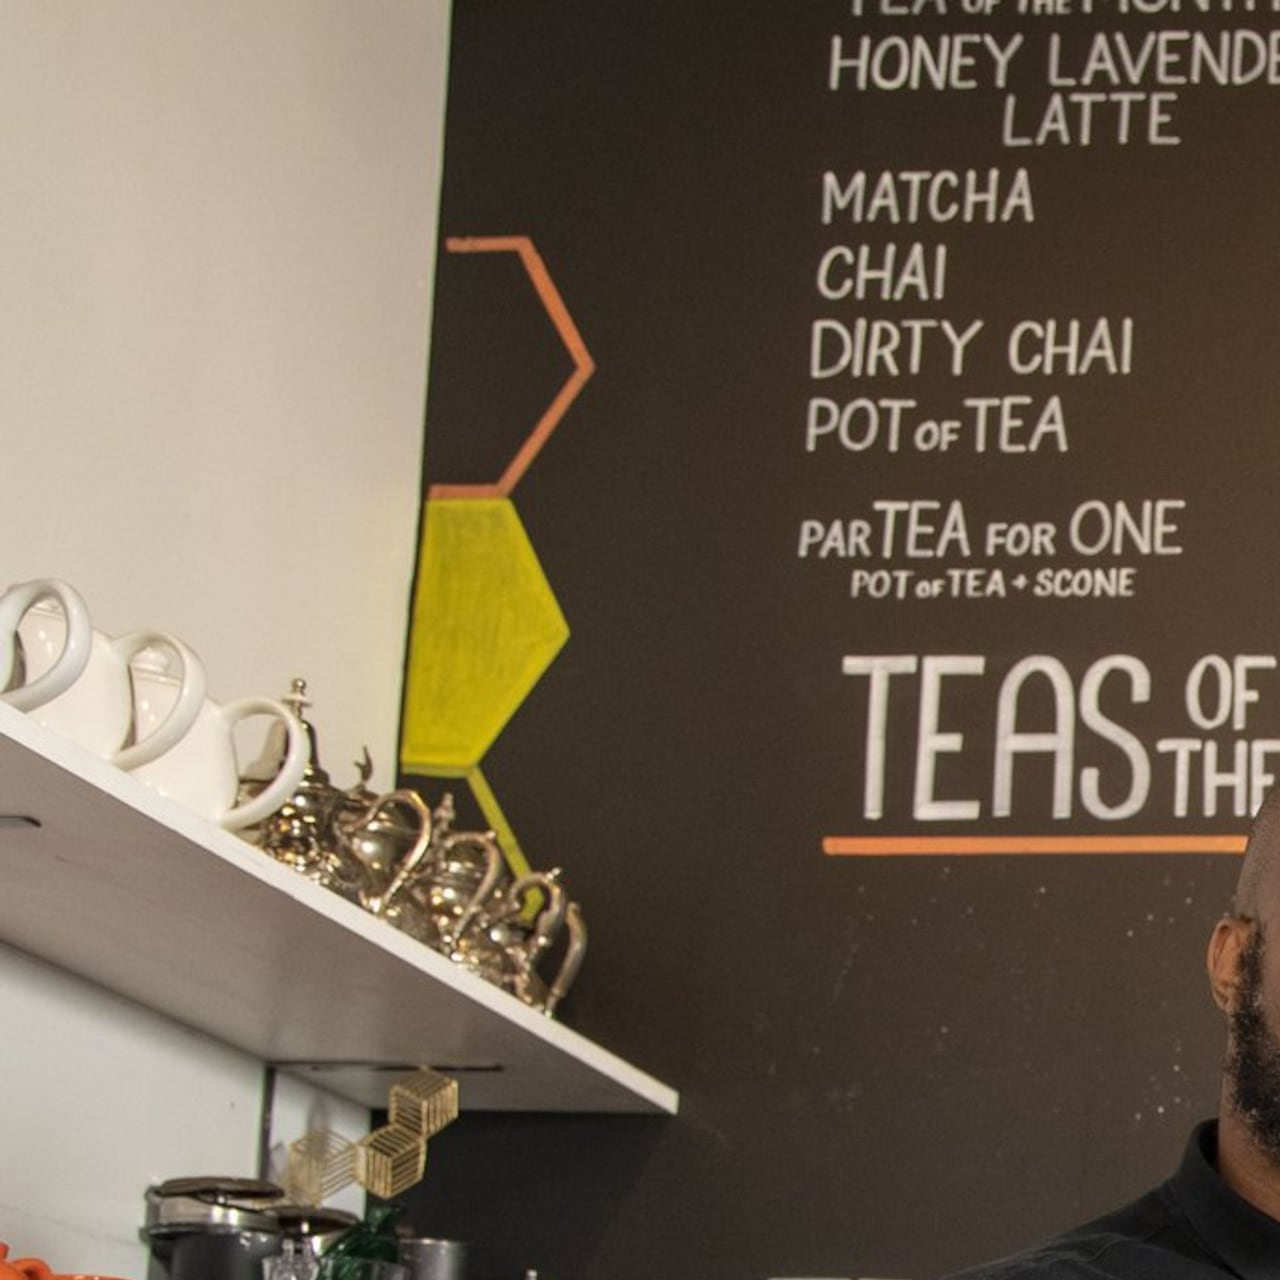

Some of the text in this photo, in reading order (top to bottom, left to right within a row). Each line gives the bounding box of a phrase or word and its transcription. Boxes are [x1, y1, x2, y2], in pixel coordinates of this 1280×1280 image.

[829, 33, 1023, 91] HONEY
[1003, 92, 1181, 147] LATTE
[822, 167, 1034, 225] MATCHA
[817, 242, 947, 301] CHAI
[810, 317, 984, 379] DIRTY
[1008, 317, 1133, 376] CHAI
[806, 397, 913, 453] POT
[964, 395, 1068, 453] TEA
[986, 522, 1057, 556] FOR
[1070, 499, 1186, 556] ONE
[851, 569, 913, 599] POT
[947, 568, 1006, 597] TEA
[1033, 567, 1136, 597] SCONE
[842, 654, 1151, 821] TEAS
[1185, 654, 1277, 731] OF
